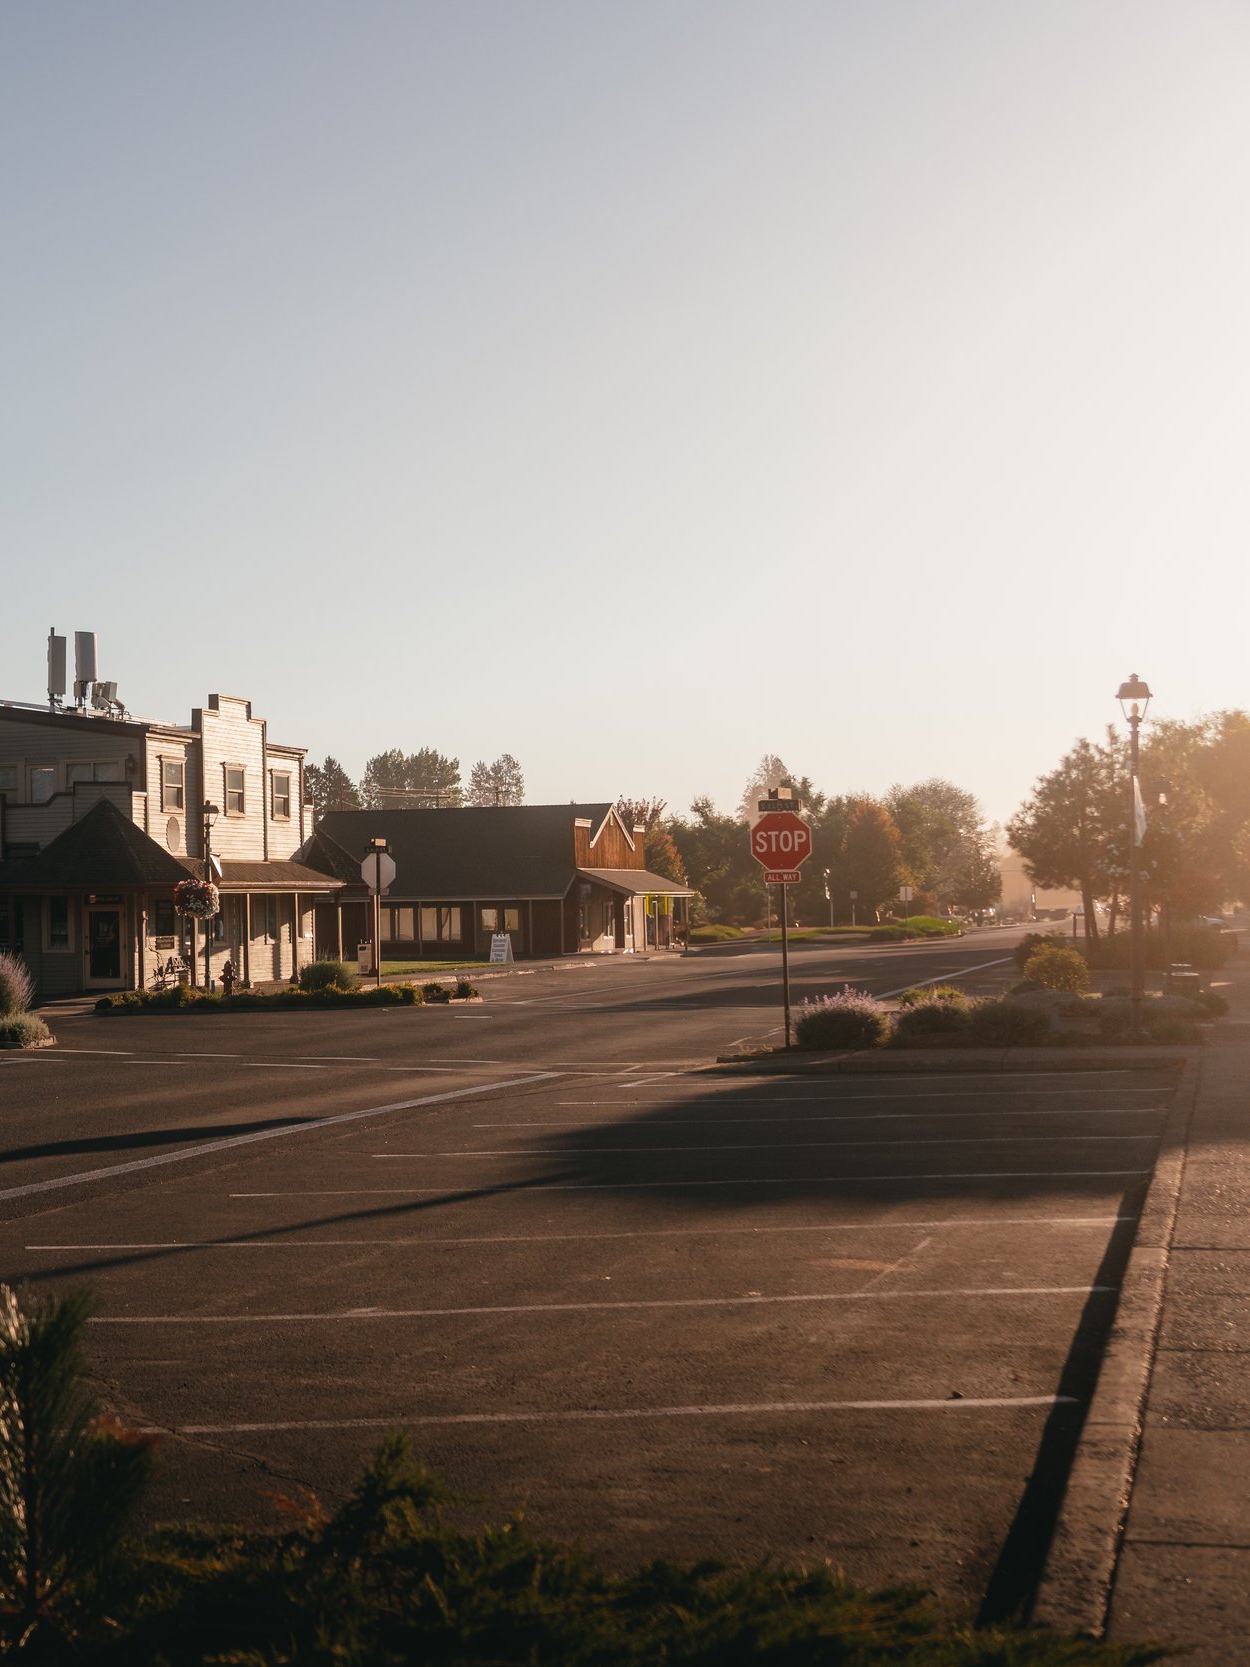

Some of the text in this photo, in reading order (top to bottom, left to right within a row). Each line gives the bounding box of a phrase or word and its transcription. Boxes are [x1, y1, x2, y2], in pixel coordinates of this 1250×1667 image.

[755, 831, 807, 853] STOP
[767, 873, 797, 881] ALL WAY
